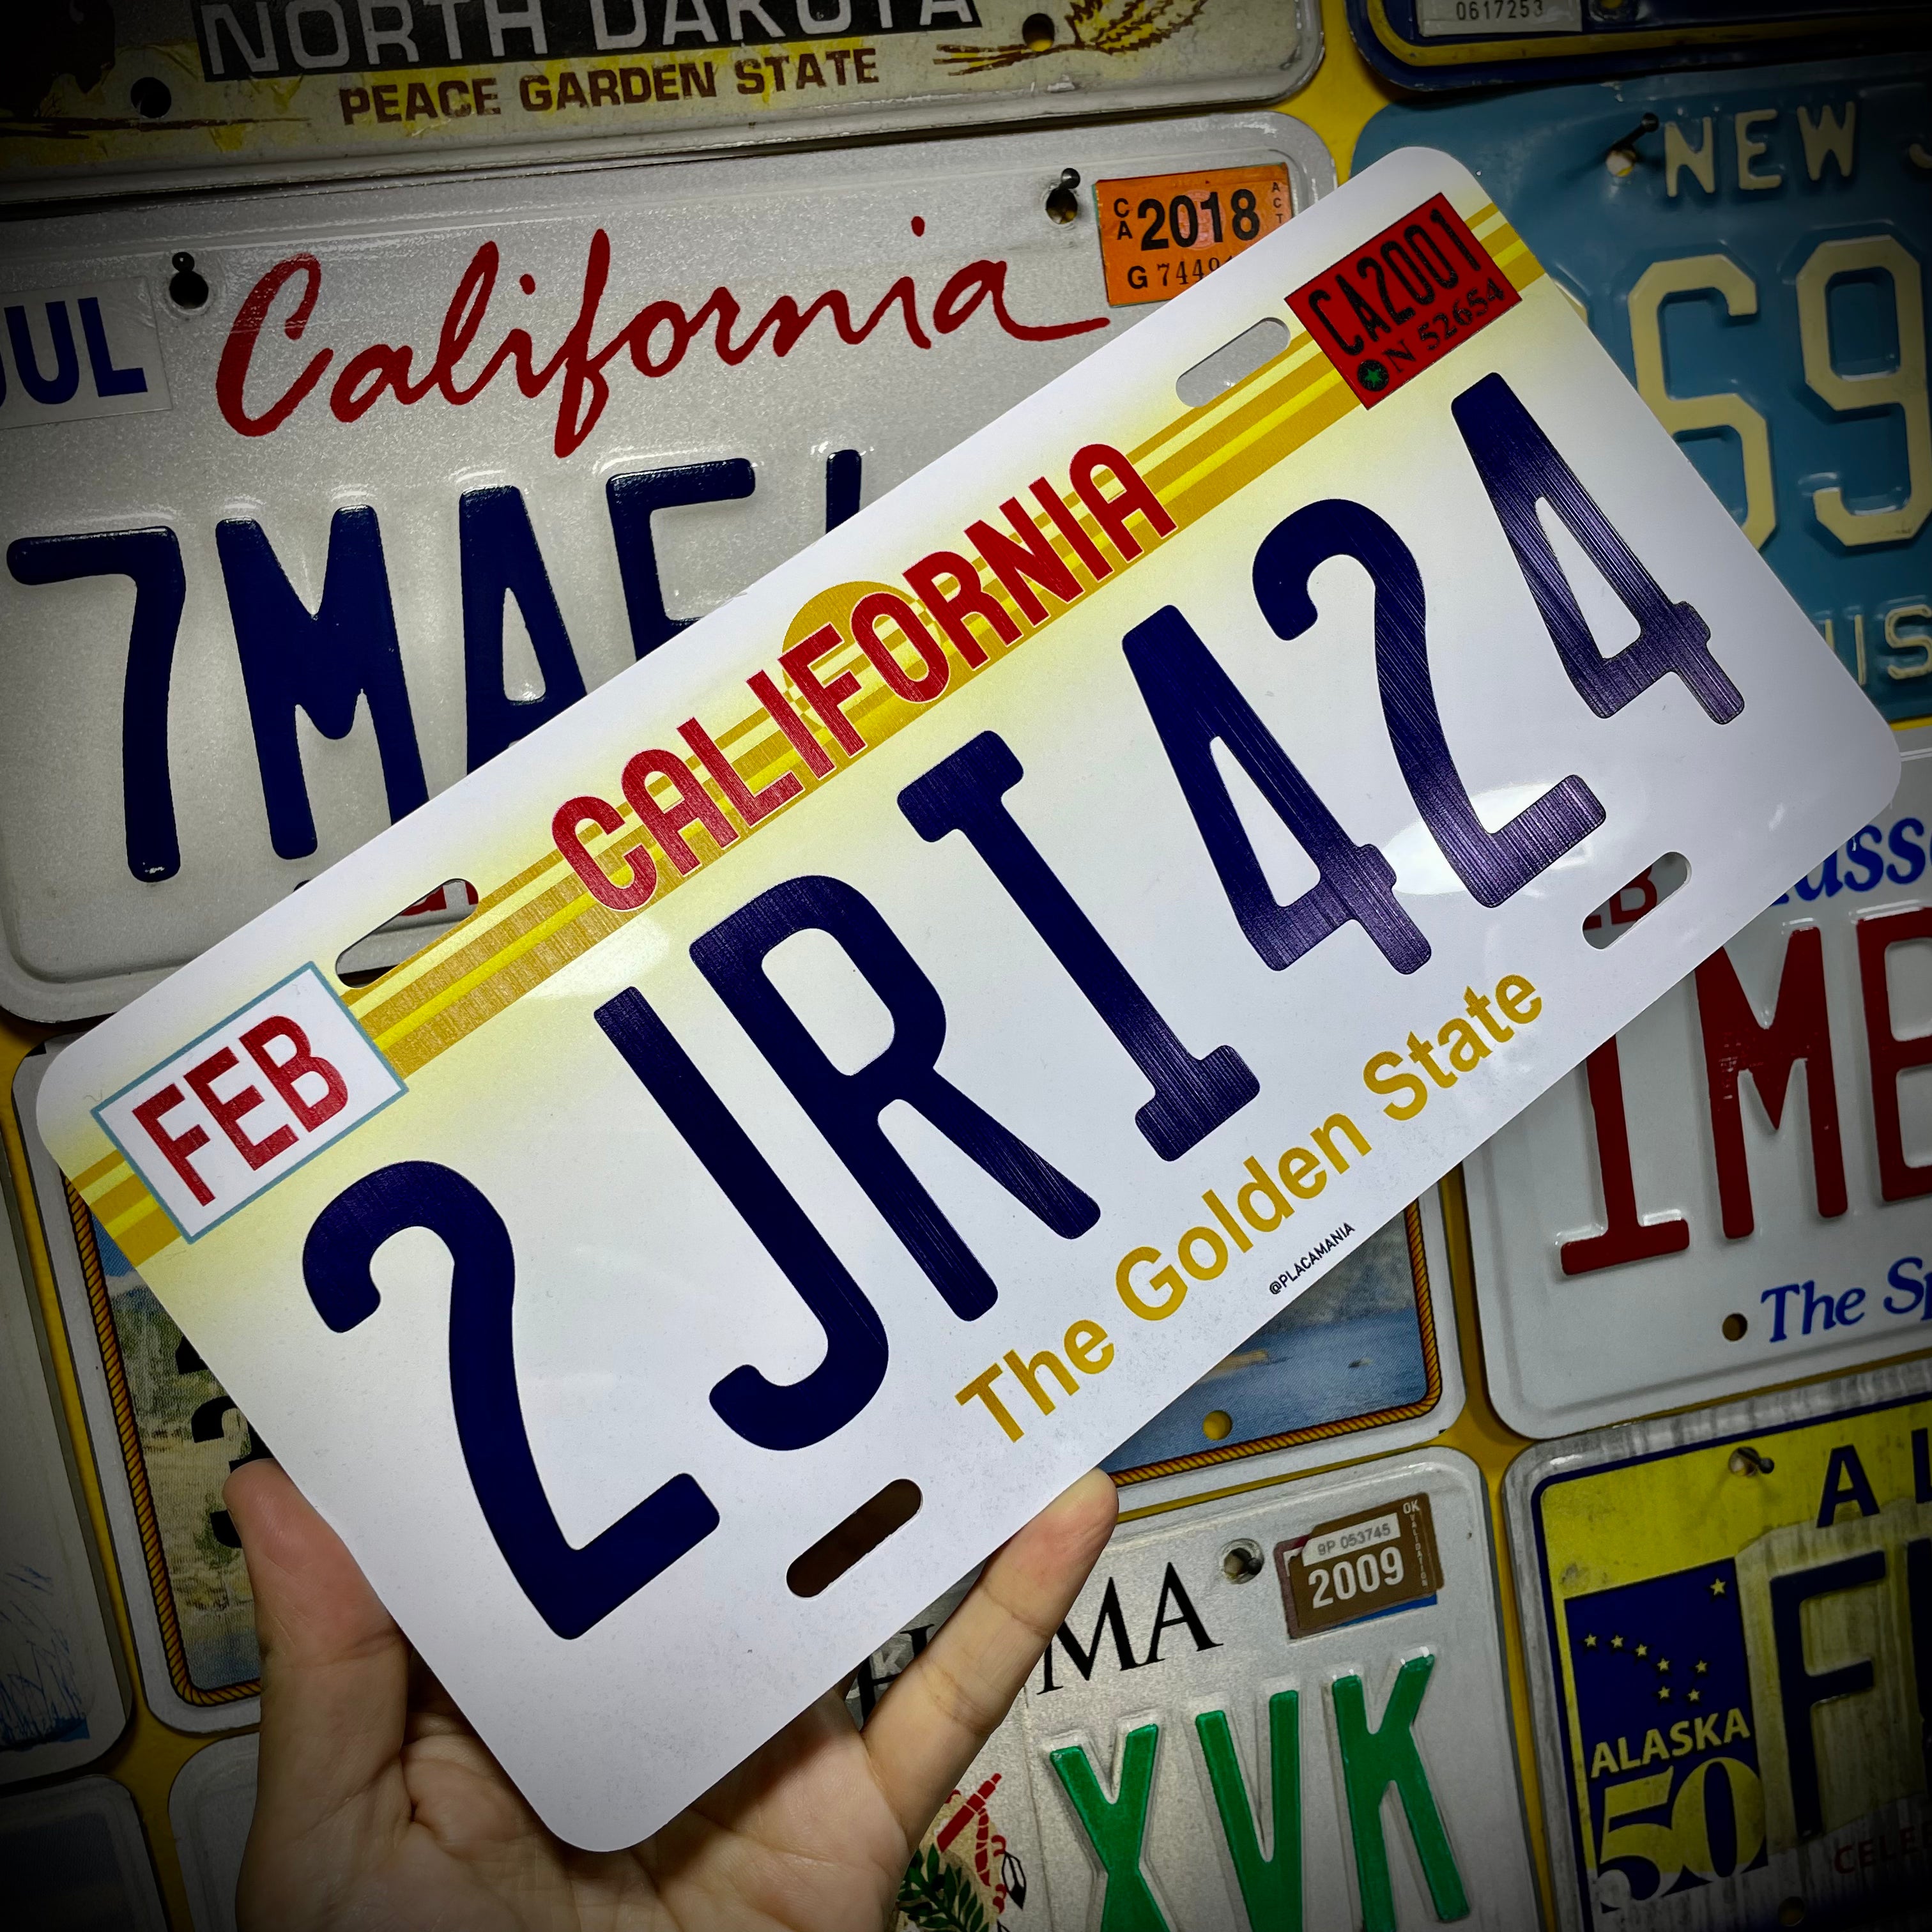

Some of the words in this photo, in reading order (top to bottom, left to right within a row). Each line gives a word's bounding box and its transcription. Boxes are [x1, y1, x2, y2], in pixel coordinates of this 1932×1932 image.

[200, 0, 550, 75] NORTH
[340, 78, 502, 125] PEACE
[520, 61, 717, 111] GARDEN
[735, 48, 878, 94] STATE
[1664, 101, 1857, 197] NEW
[1137, 189, 1260, 250] 2018
[1308, 208, 1482, 356] CA2001
[1418, 277, 1505, 351] 52654
[0, 297, 148, 404] UL
[216, 216, 1110, 458] California
[551, 443, 1177, 912] CALIFORNIA
[303, 372, 1745, 1639] 2JRI424
[132, 1016, 348, 1206] FEB
[958, 1319, 1114, 1443] The
[1116, 1113, 1372, 1321] Golden
[1363, 974, 1542, 1121] State
[1269, 1222, 1356, 1295] @PLACAMANIA
[1761, 1280, 1866, 1342] The
[1308, 1546, 1404, 1609] 2009
[1590, 1706, 1752, 1779] ALASKA
[1050, 1655, 1470, 1932] XVK
[1597, 1756, 1768, 1914] 50
